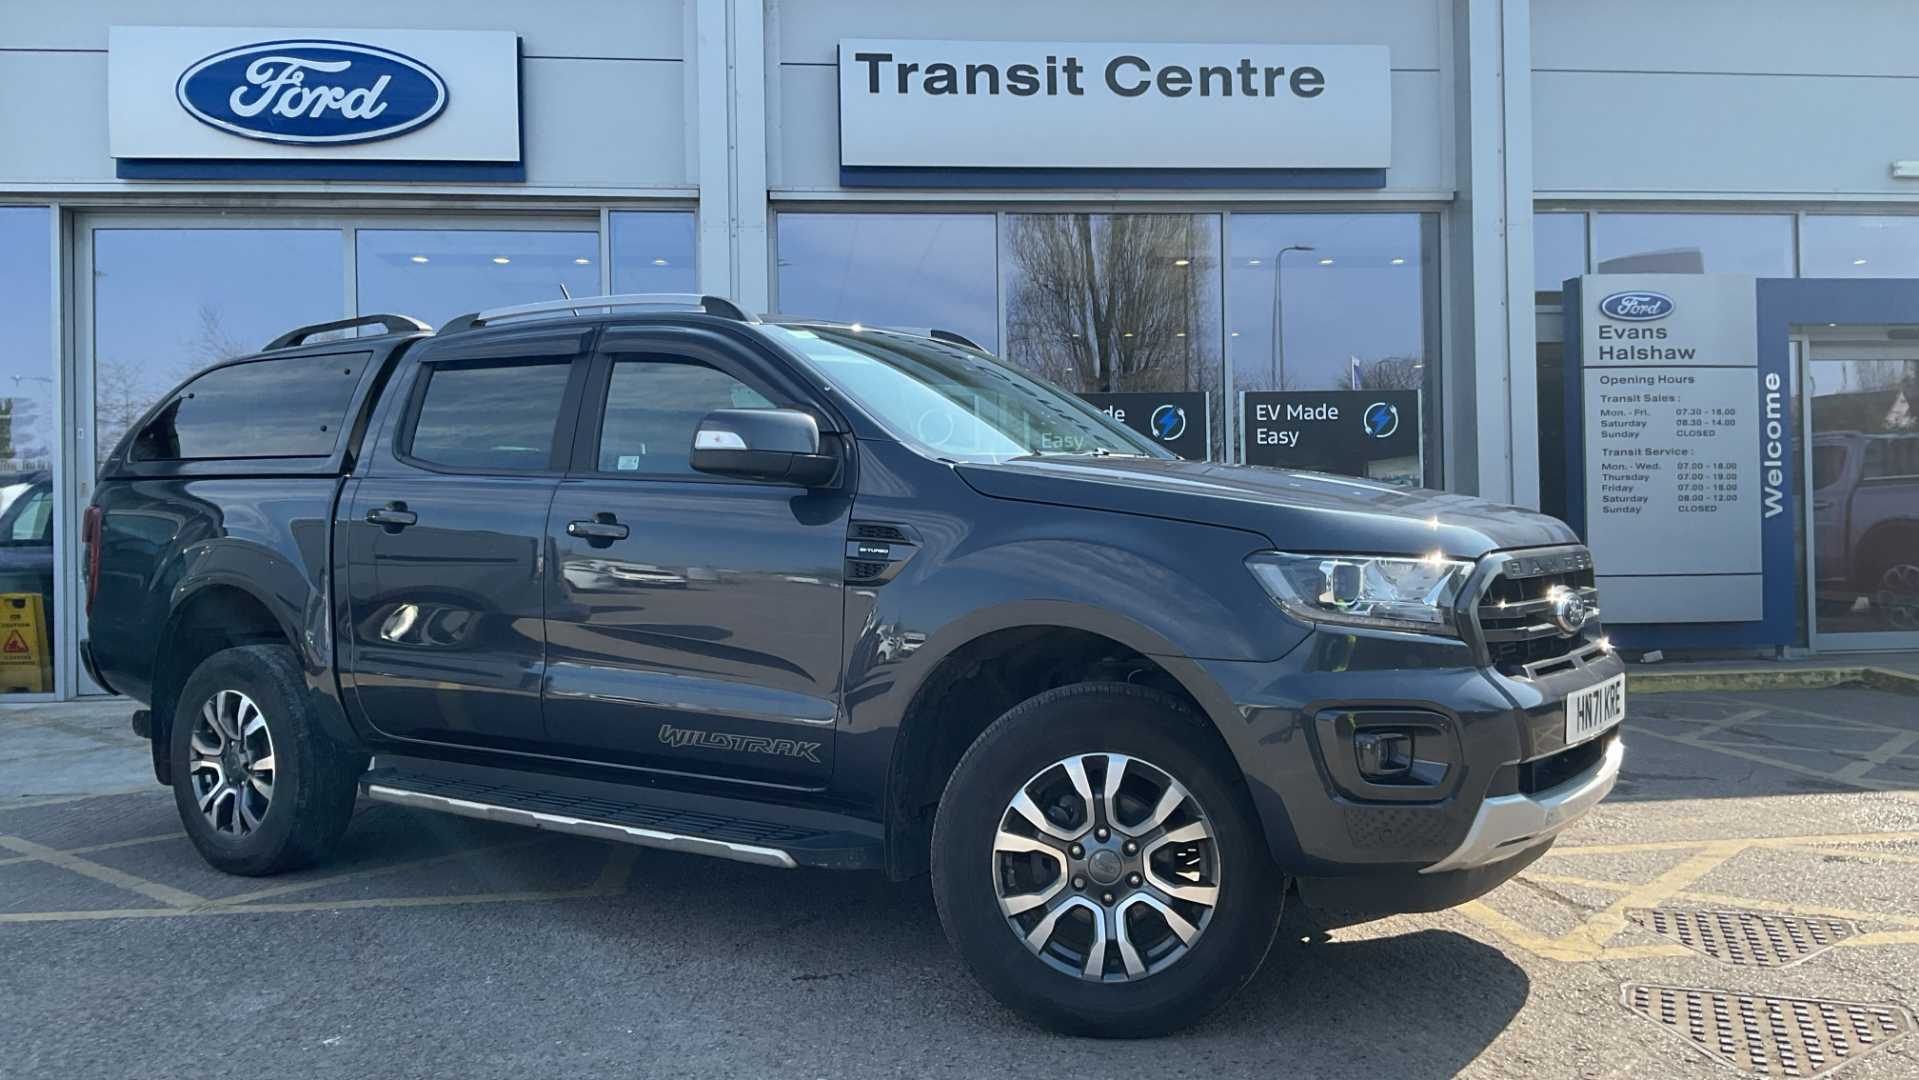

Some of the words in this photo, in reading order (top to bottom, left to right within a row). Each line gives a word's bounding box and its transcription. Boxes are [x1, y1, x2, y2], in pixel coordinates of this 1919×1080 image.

[854, 52, 1084, 97] Transit
[1103, 55, 1326, 98] Centre
[229, 56, 391, 120] Ford
[1617, 296, 1661, 314] Ford
[1598, 325, 1668, 340] Evans
[1598, 345, 1696, 361] Halshaw
[1599, 375, 1655, 386] Opening
[1658, 374, 1695, 384] Hours
[1600, 394, 1641, 403] Transit
[1255, 404, 1281, 421] EV
[1286, 403, 1339, 420] Made
[1600, 420, 1647, 428] Saturday
[1711, 419, 1736, 427] 14.00
[1041, 432, 1085, 449] Easy
[1256, 428, 1300, 447] Easy
[1601, 430, 1640, 439] Sunday
[1676, 429, 1716, 437] CLOSED
[1602, 448, 1641, 456] Transit
[1644, 447, 1689, 456] Service
[1763, 372, 1784, 519] Welcome
[1635, 462, 1661, 470] Wed.
[1677, 462, 1703, 470] 07.00
[1602, 473, 1650, 482] Thursday
[1602, 484, 1634, 493] Friday
[1677, 484, 1703, 492] 07.00
[1602, 495, 1649, 504] Saturday
[1602, 505, 1642, 514] Sunday
[1678, 505, 1717, 513] CLOSED
[1577, 689, 1602, 734] HN71
[1604, 681, 1620, 721] KRE
[658, 724, 821, 763] WILDTRAK
